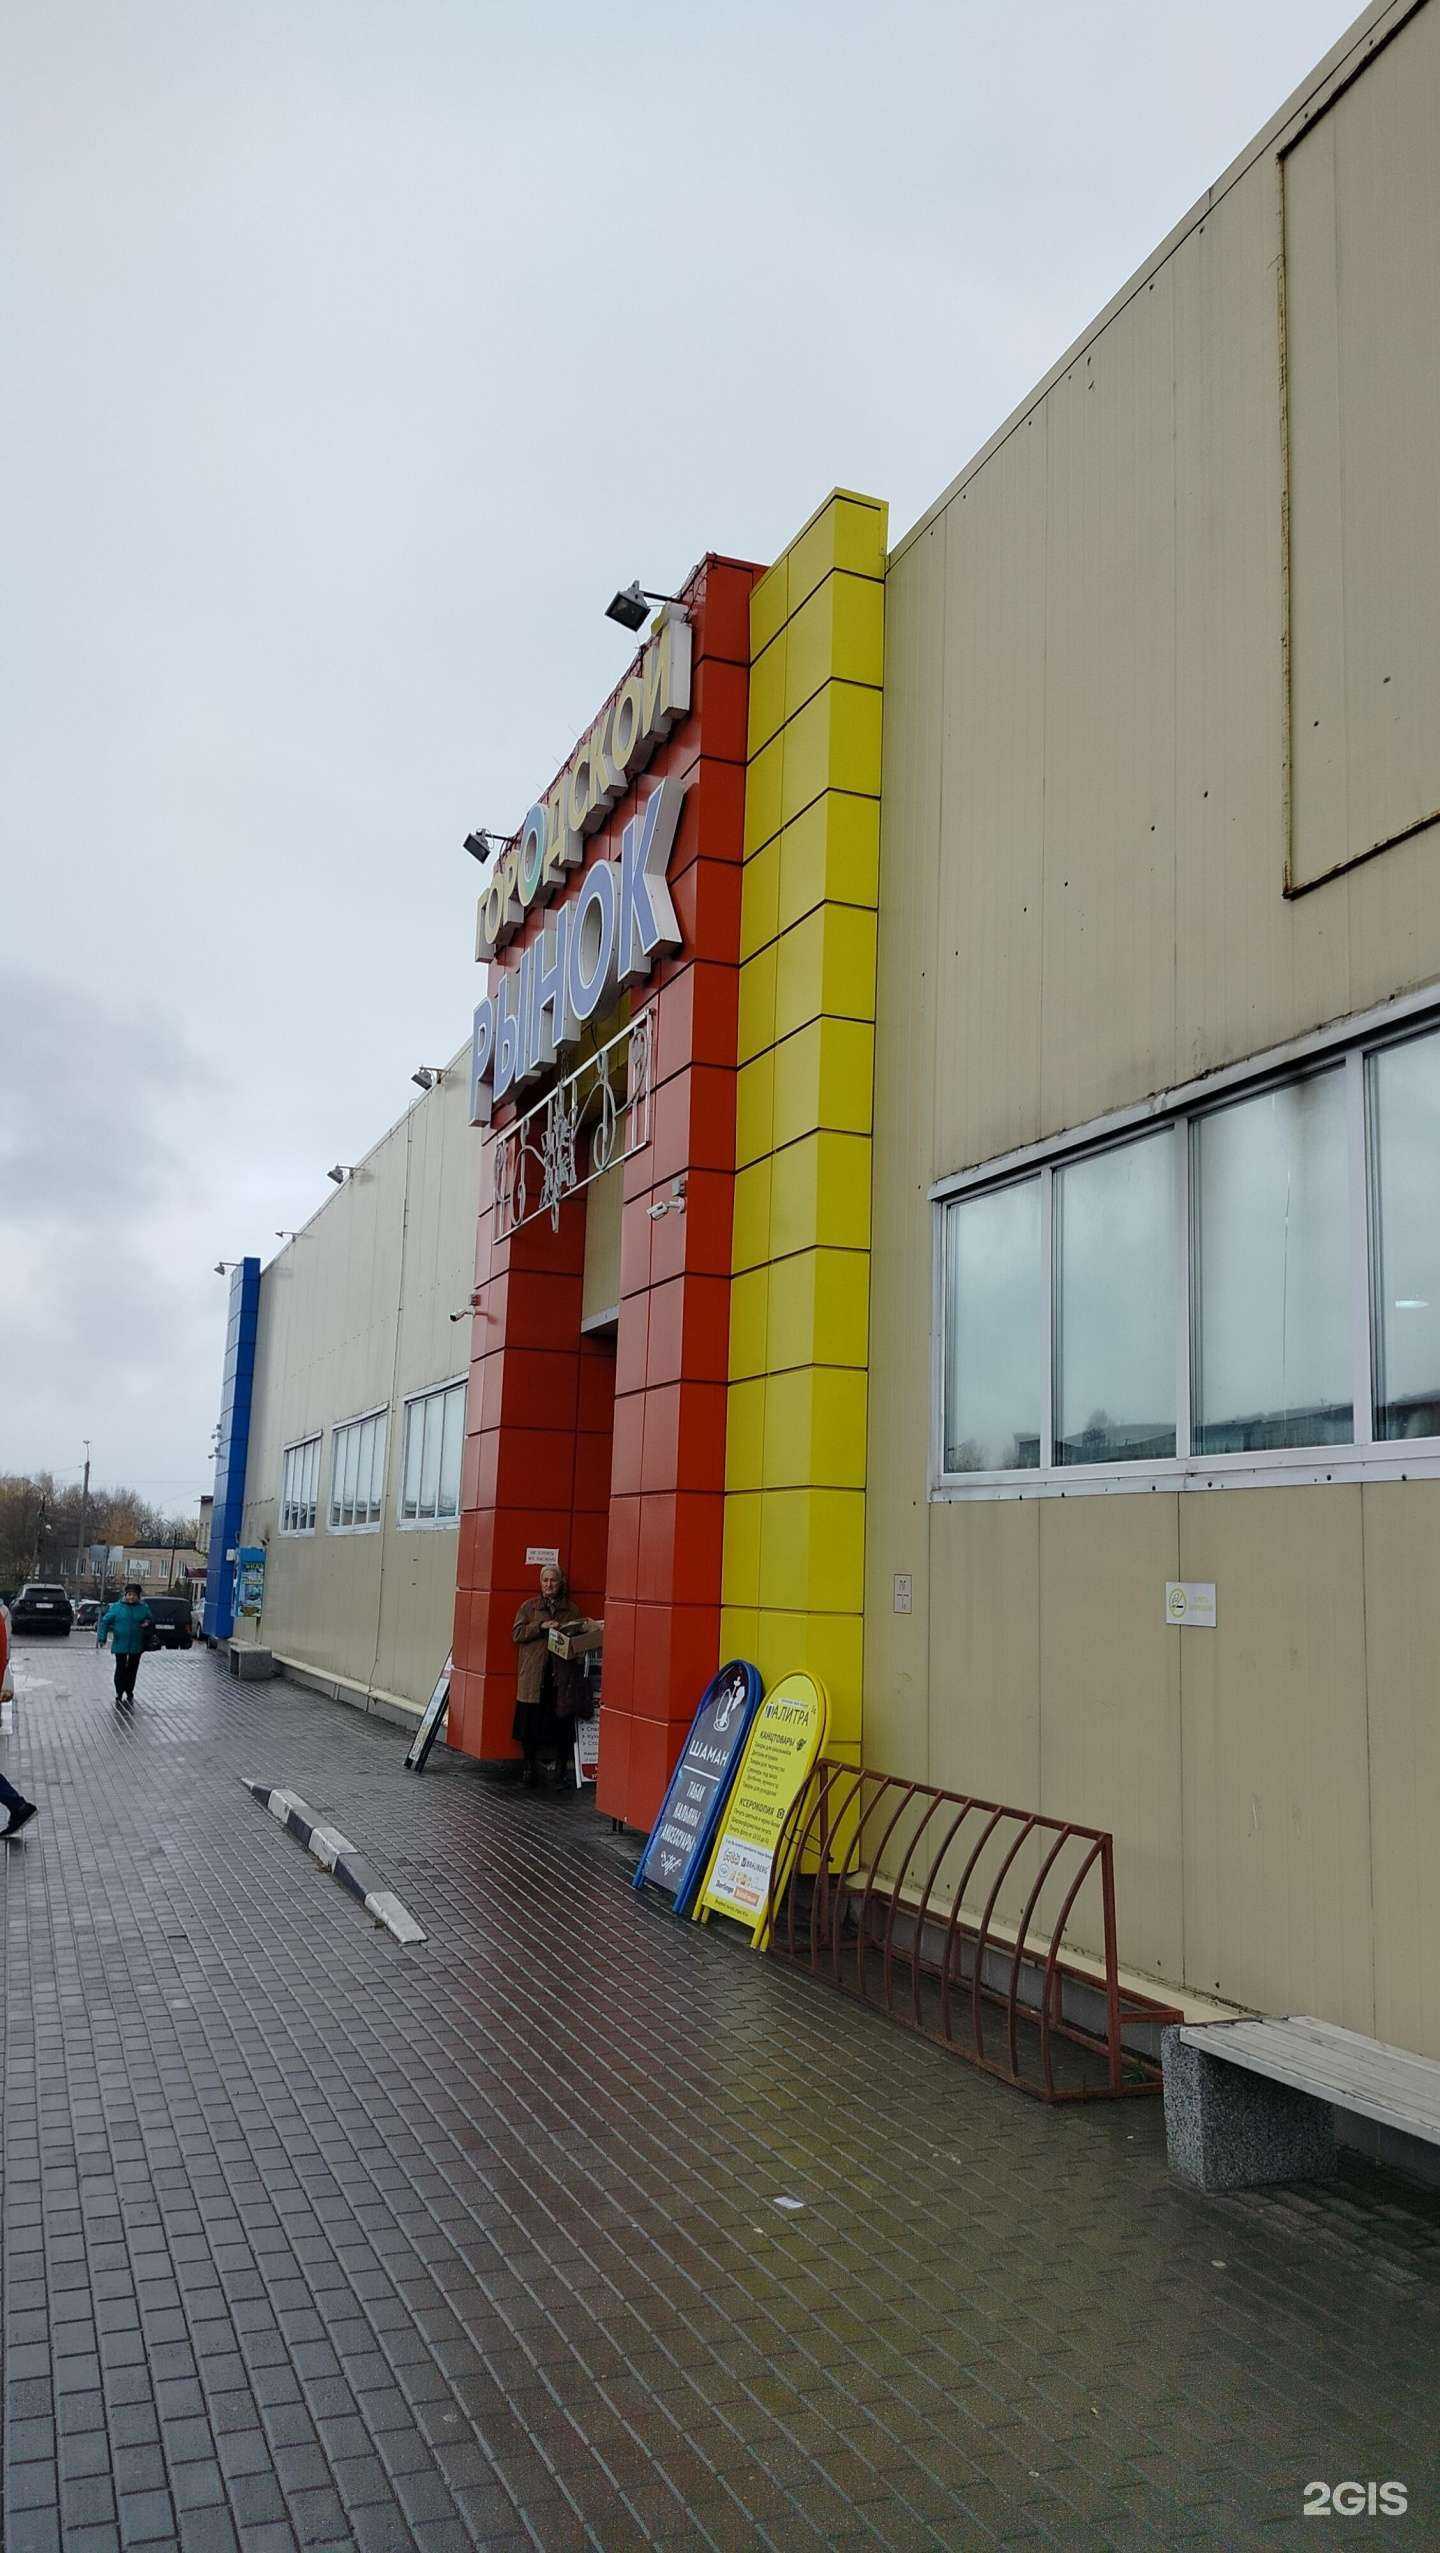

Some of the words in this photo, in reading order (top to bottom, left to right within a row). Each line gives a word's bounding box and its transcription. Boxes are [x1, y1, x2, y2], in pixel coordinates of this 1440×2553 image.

[475, 603, 692, 962] ГОРОДСКОЙ
[469, 777, 684, 1127] РЫНОК
[688, 1739, 730, 1766] ШАМАН
[740, 1797, 775, 1815] КСЕРОКОПИЯ
